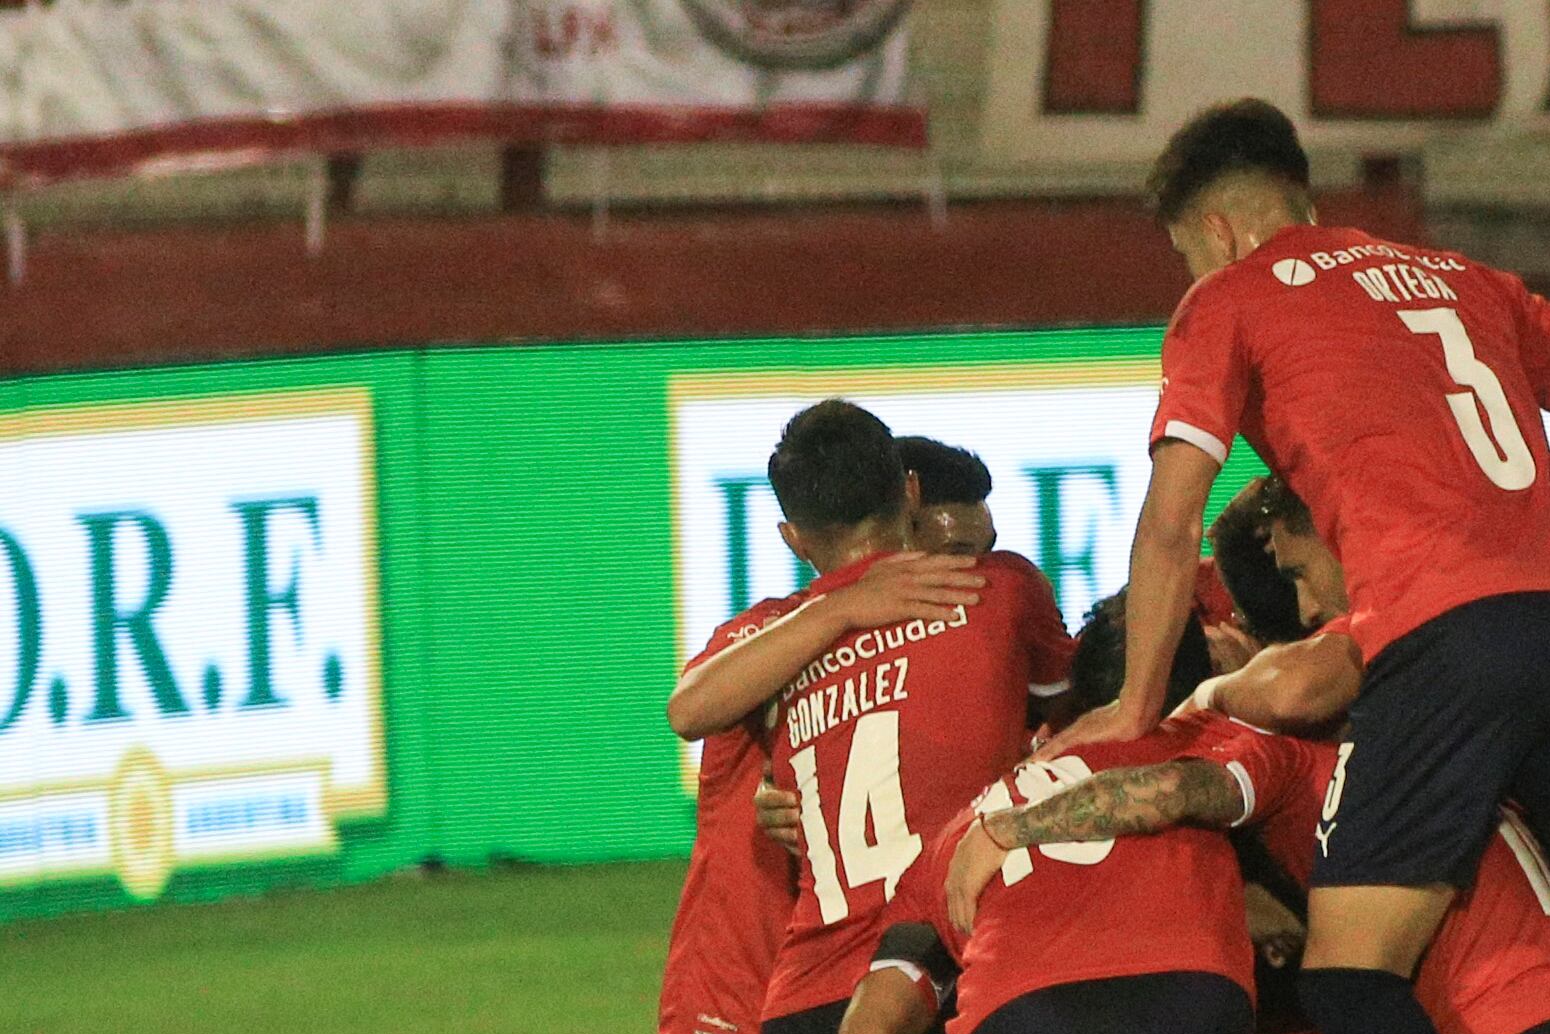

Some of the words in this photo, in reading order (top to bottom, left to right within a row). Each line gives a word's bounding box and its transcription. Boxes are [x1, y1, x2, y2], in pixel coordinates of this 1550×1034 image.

[1352, 263, 1458, 302] ORTEGA
[1397, 308, 1537, 491] 3
[786, 657, 908, 749] GONZALEZ
[789, 710, 923, 926] 14
